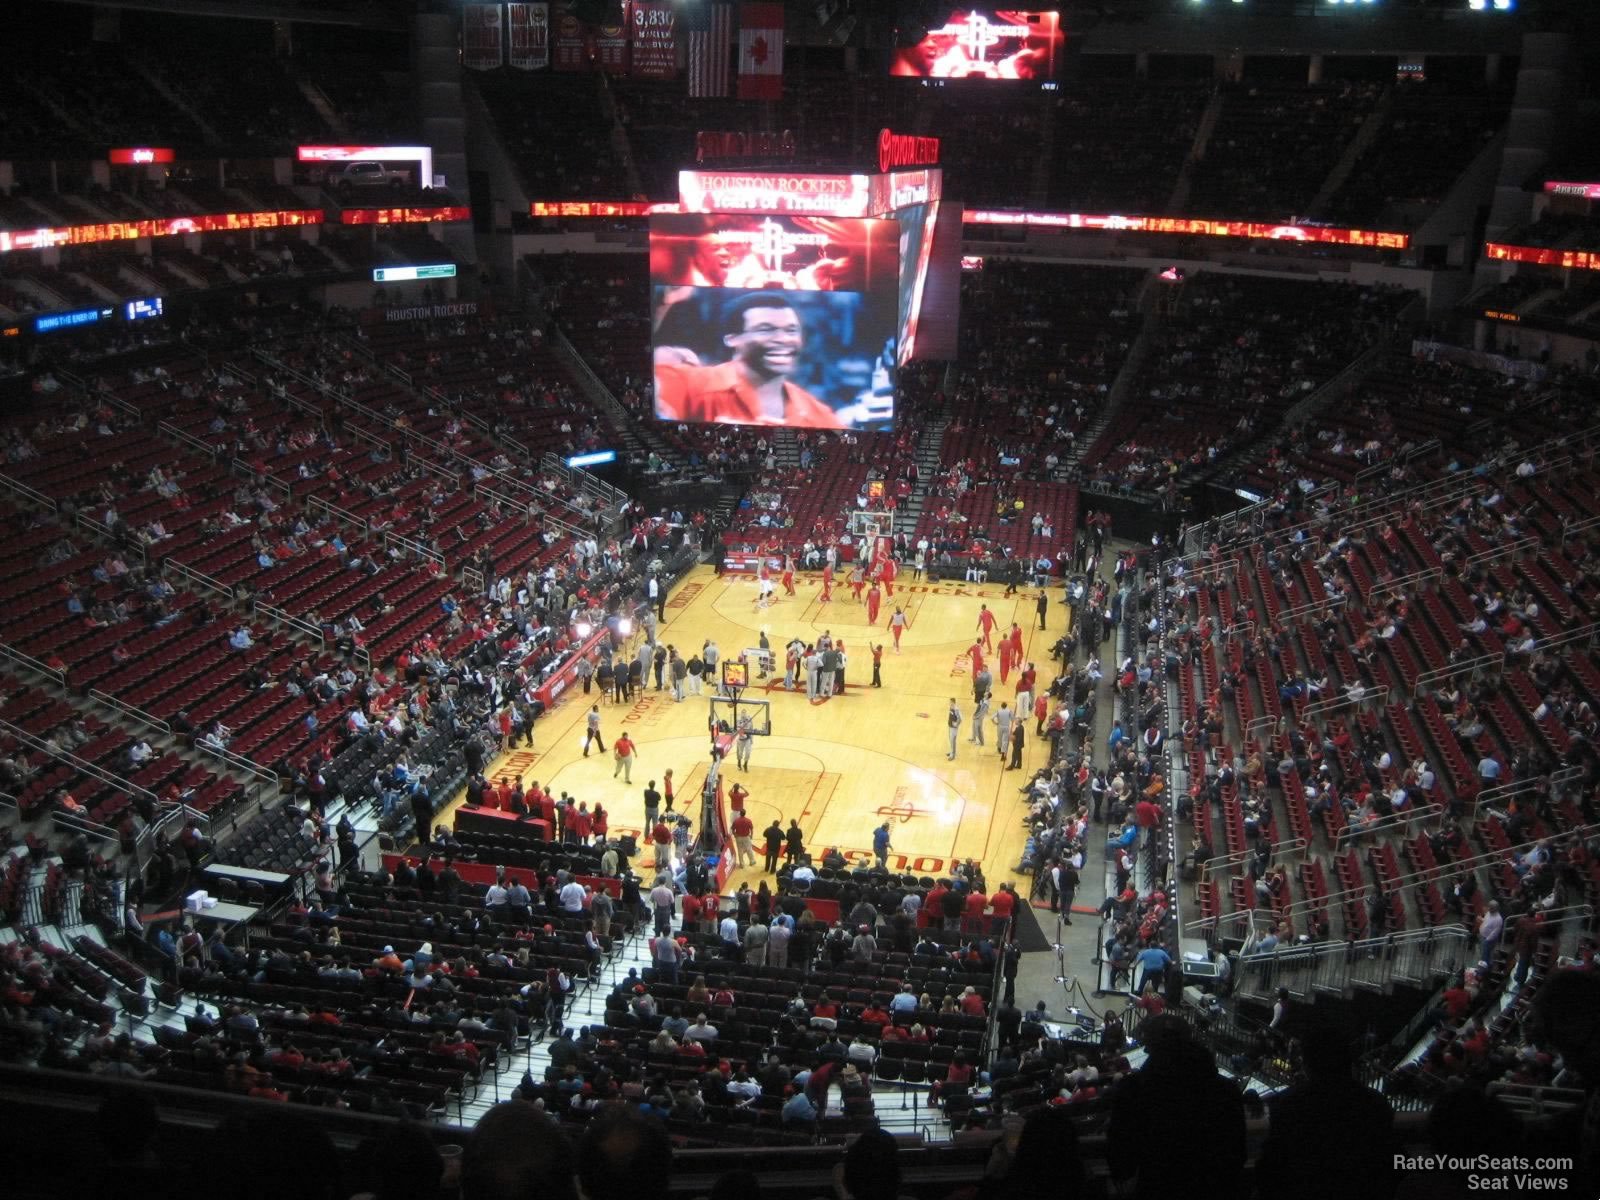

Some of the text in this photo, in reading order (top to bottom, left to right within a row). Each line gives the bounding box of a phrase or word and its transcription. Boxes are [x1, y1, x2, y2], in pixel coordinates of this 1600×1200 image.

[702, 176, 847, 193] HOUSTON ROCKETS
[386, 303, 478, 321] HOUSTON ROCKETS
[39, 317, 59, 329] BRING
[620, 696, 658, 725] TOYOTA
